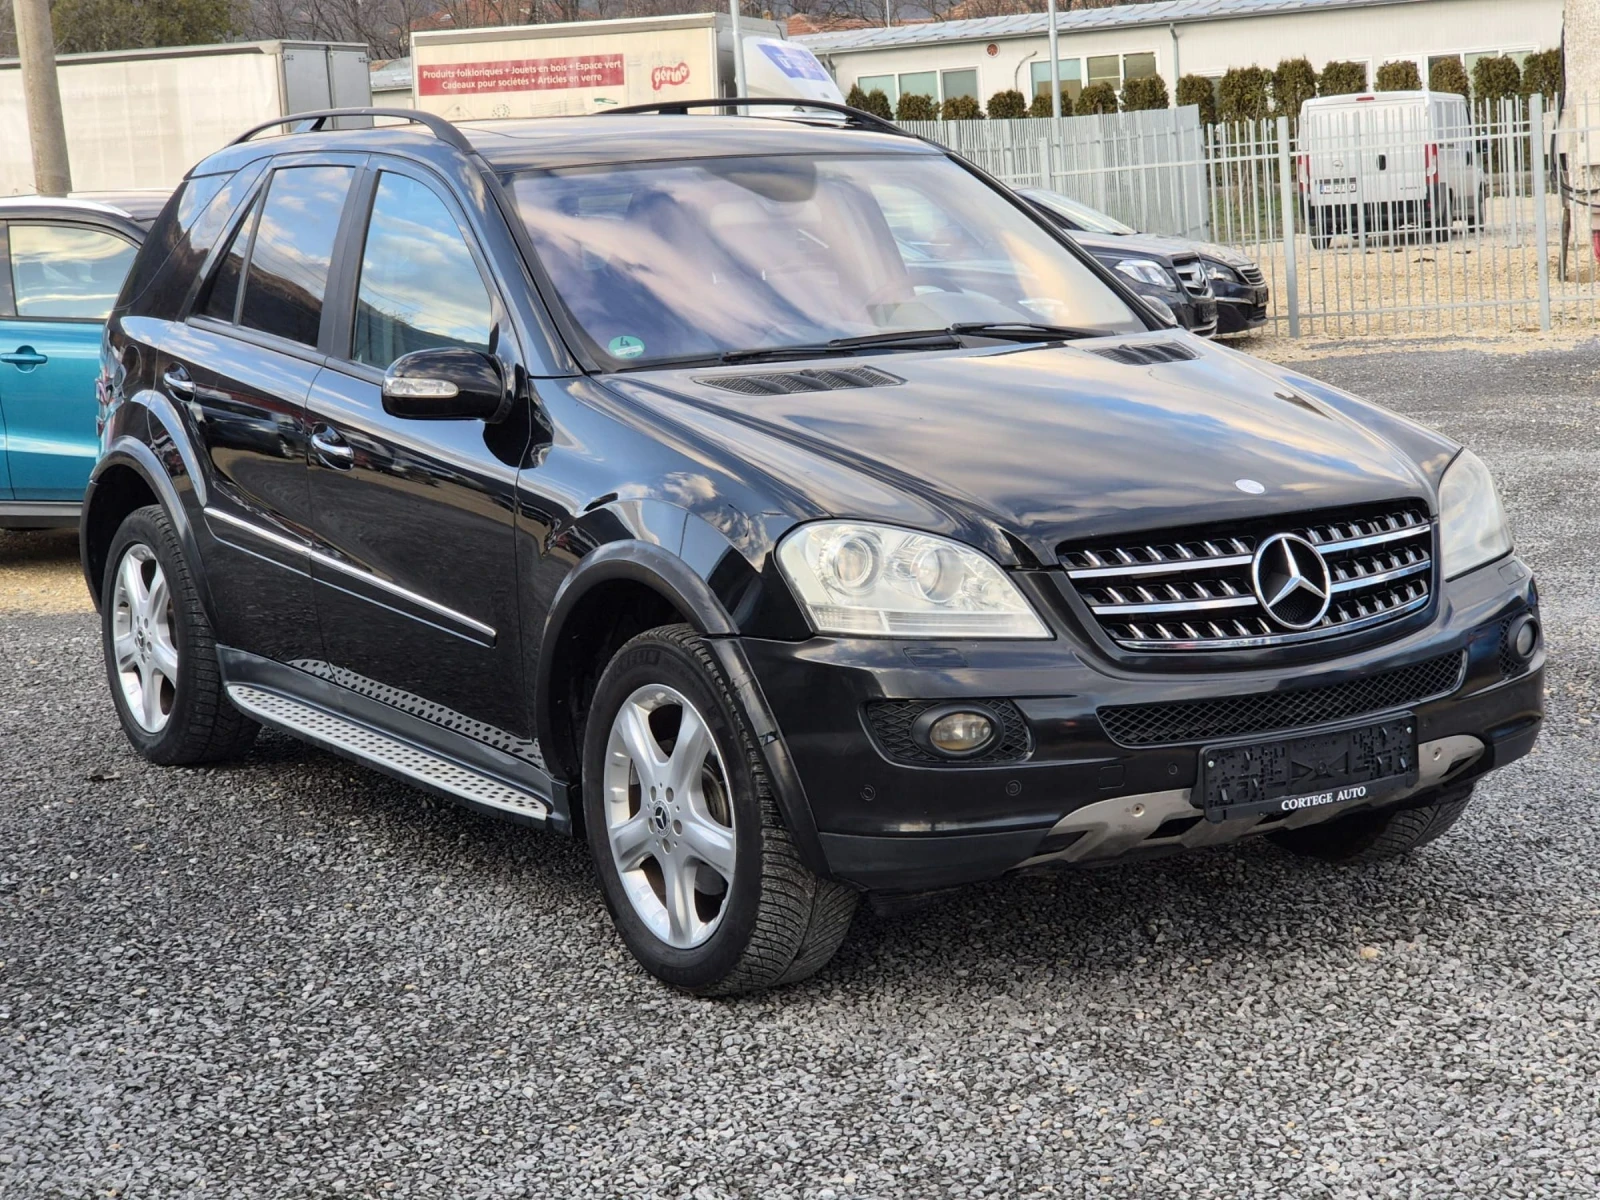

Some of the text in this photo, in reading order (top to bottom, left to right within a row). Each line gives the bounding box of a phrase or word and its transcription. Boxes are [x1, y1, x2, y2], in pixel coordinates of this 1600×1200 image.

[423, 59, 622, 79] Produits folkloriques Jouets en bois Espace vert
[442, 73, 603, 90] Cadeaux pour sociétés Articles en verre
[1281, 786, 1367, 811] CORTEGE AUTO
